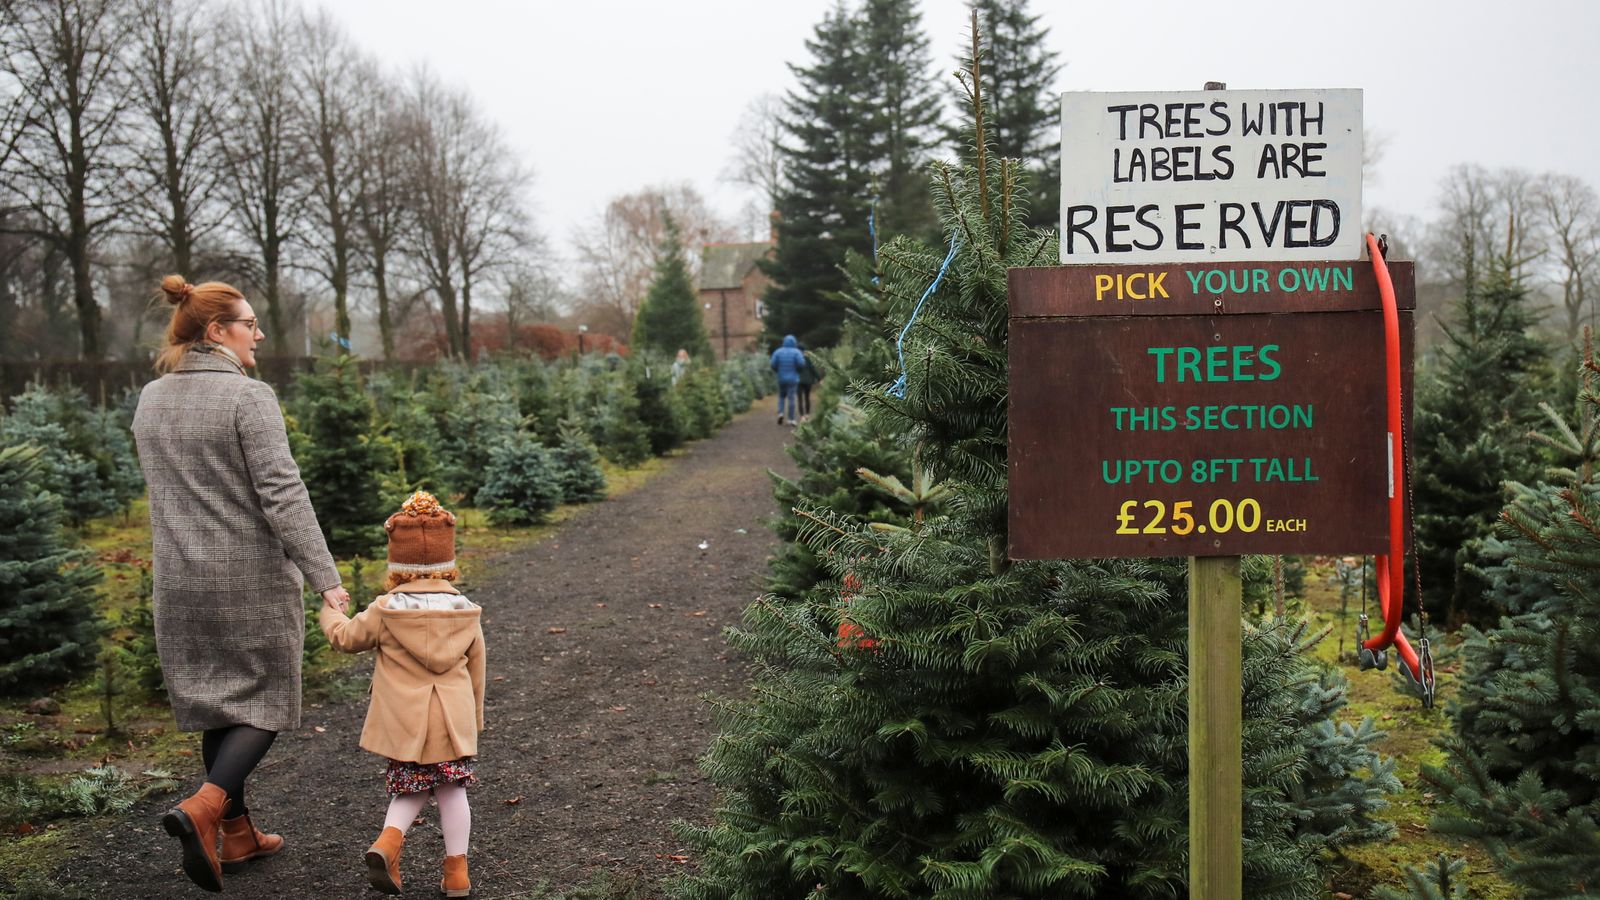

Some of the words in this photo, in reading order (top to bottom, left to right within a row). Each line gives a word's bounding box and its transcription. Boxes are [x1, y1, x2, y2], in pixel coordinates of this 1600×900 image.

[1107, 101, 1232, 141] TREES
[1241, 101, 1324, 137] WITH
[1113, 145, 1235, 184] LABELS
[1257, 142, 1328, 180] ARE
[1066, 199, 1341, 255] RESERVED
[1094, 271, 1170, 302] PICK
[1187, 269, 1270, 297] YOUR
[1278, 267, 1353, 291] OWN
[1147, 344, 1281, 383] TREES
[1110, 406, 1177, 431] THIS
[1185, 404, 1313, 431] SECTION
[1102, 459, 1183, 484] UPTO
[1191, 458, 1241, 483] 8FT
[1248, 457, 1318, 482] TALL
[1115, 497, 1262, 536] £25.00
[1266, 518, 1307, 532] EACH
